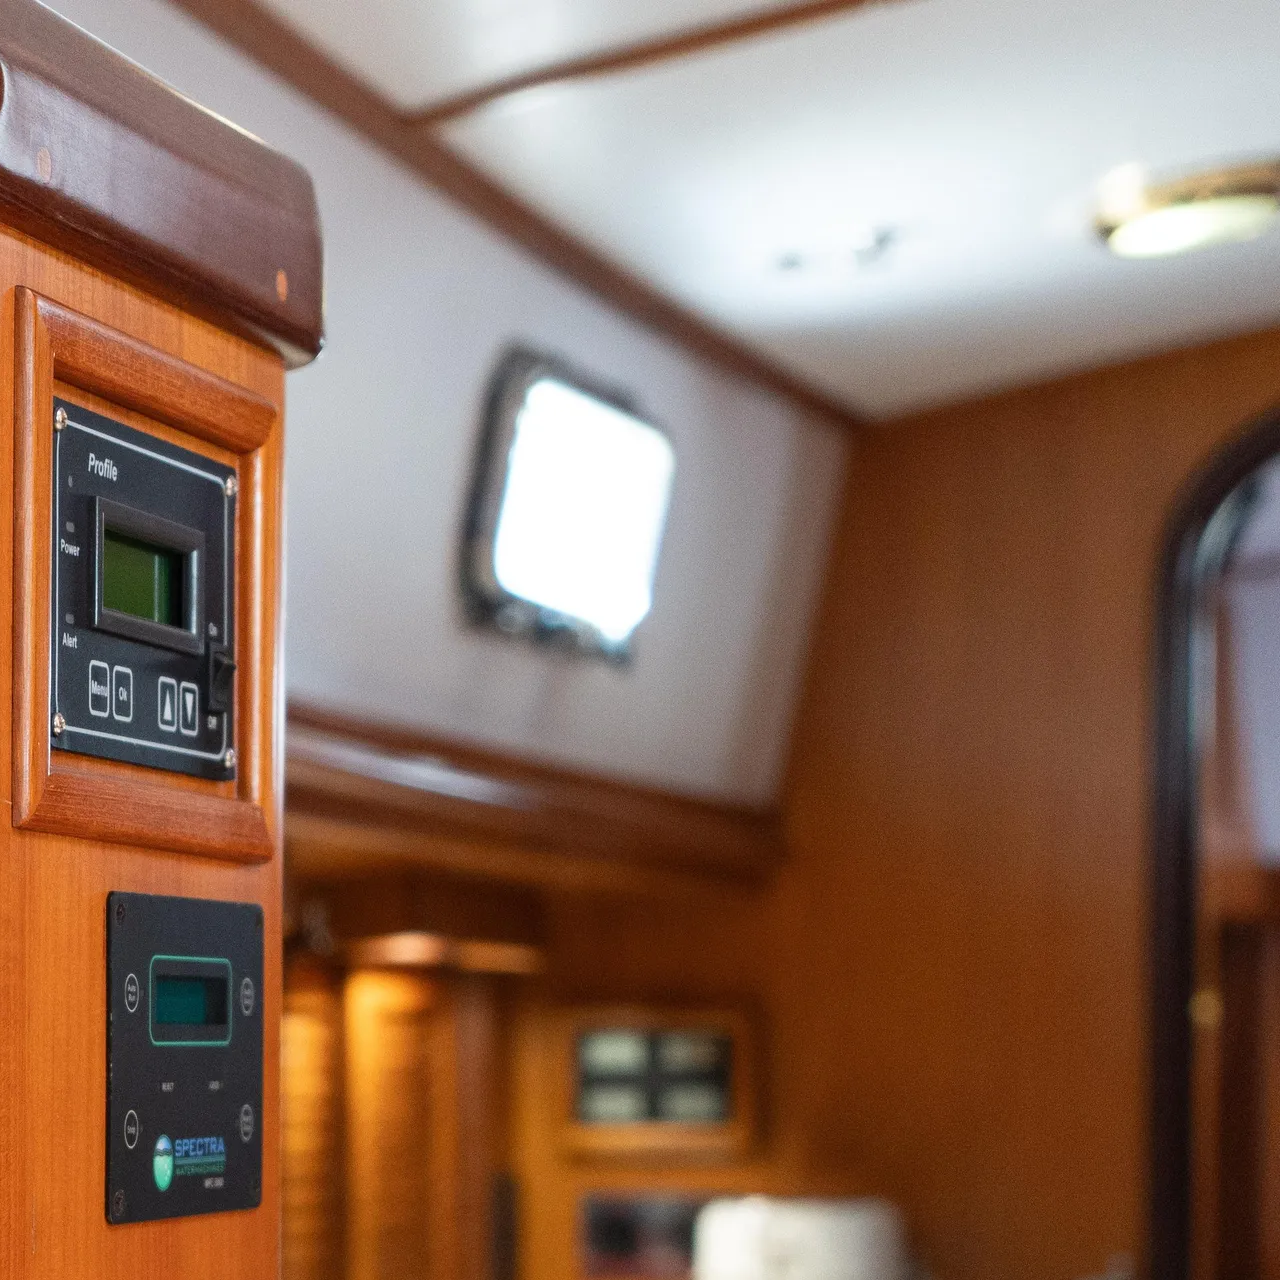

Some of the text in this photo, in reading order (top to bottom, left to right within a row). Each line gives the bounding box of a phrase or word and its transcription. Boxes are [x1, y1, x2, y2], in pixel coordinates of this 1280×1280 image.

[88, 453, 118, 482] Profile
[60, 539, 80, 557] Power
[62, 633, 78, 649] Alert
[91, 680, 108, 698] Menu
[174, 1137, 225, 1157] SPECTRA
